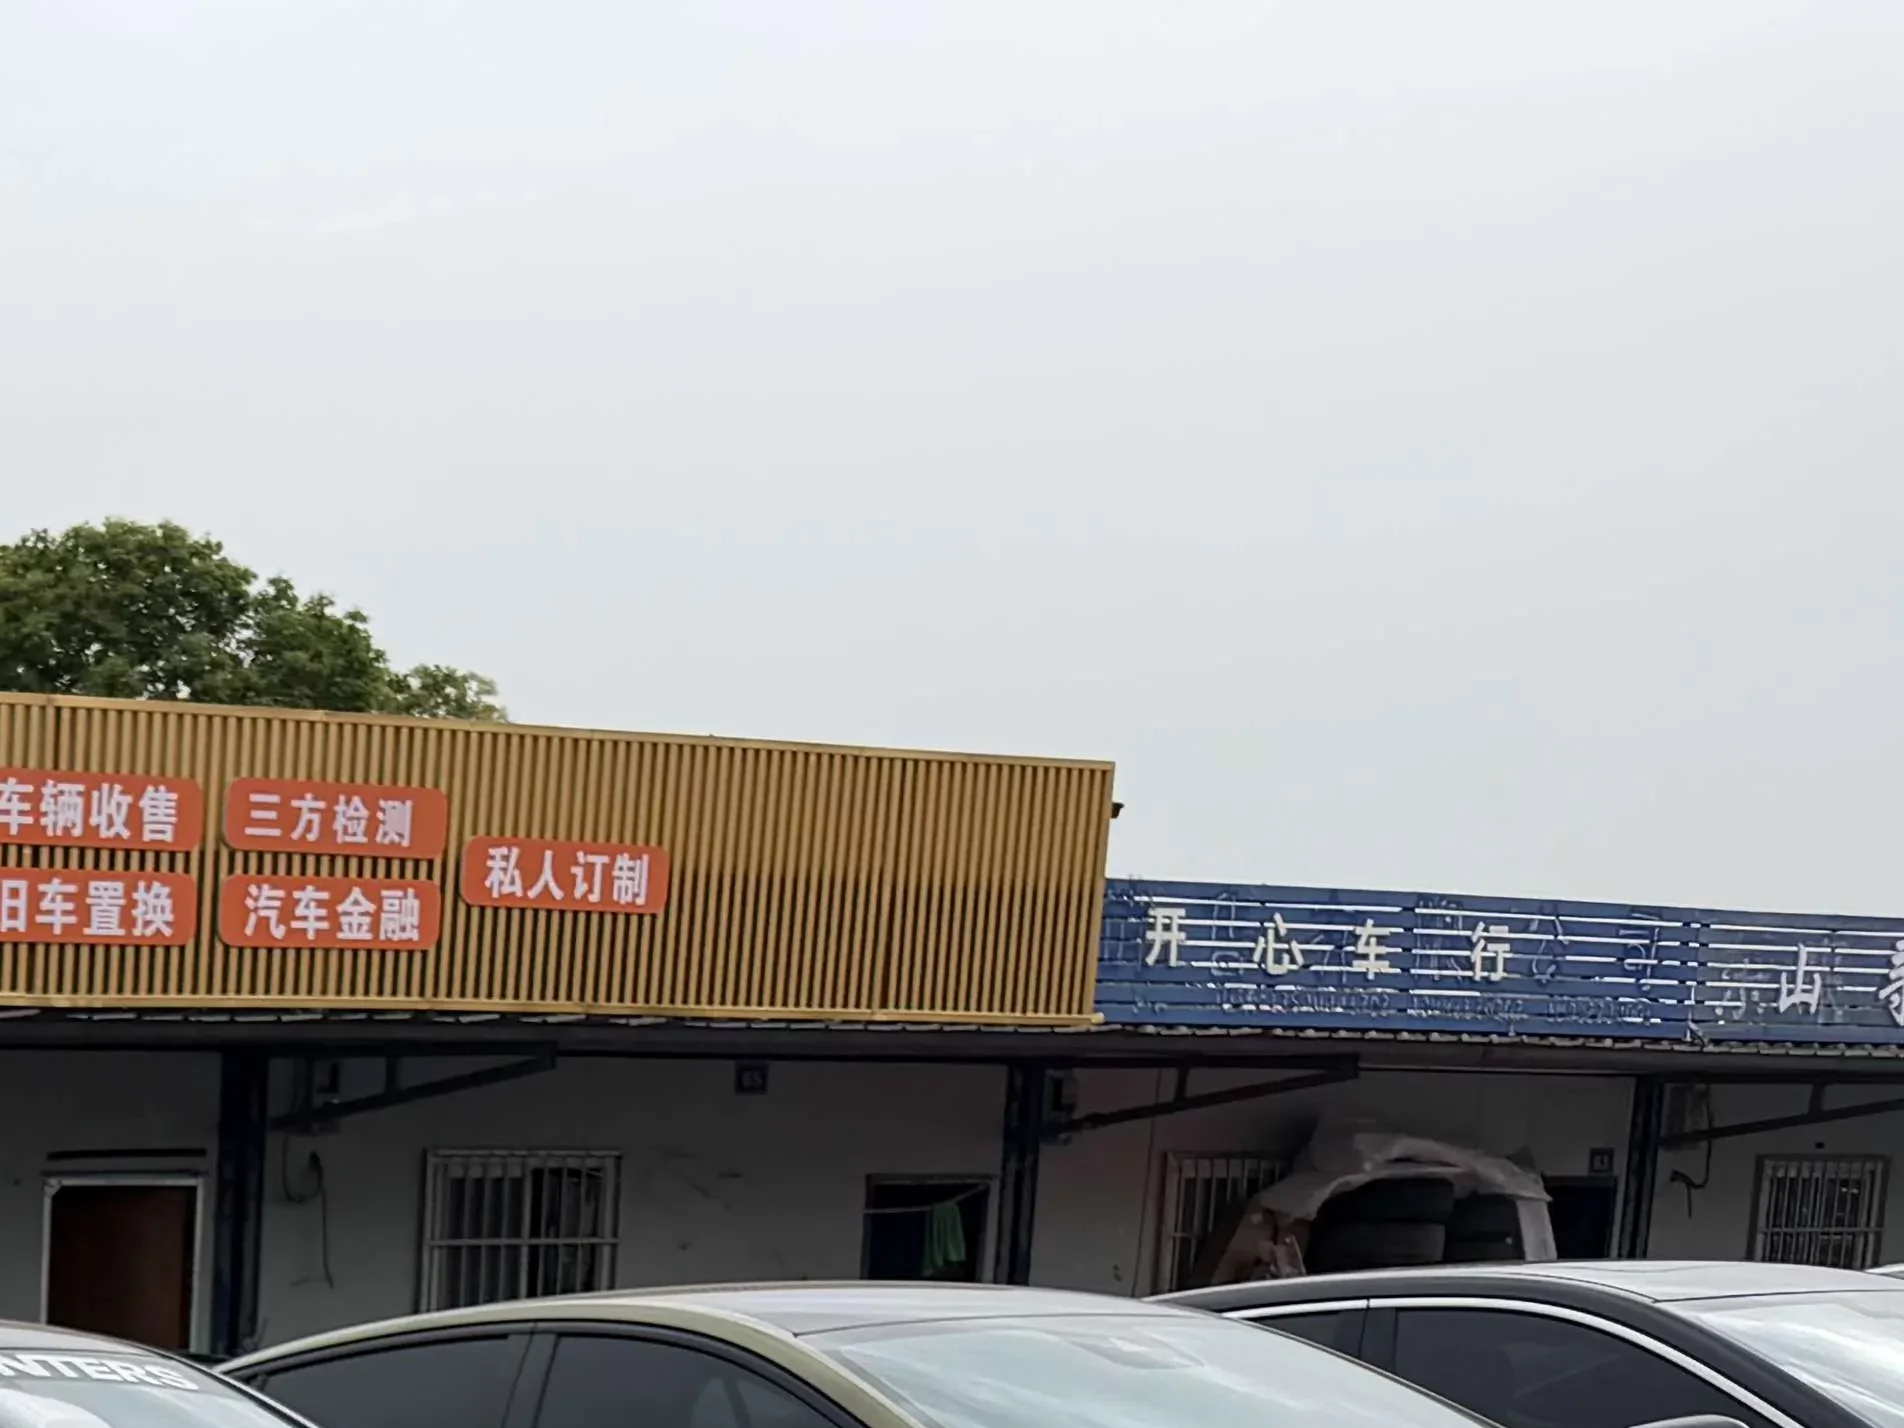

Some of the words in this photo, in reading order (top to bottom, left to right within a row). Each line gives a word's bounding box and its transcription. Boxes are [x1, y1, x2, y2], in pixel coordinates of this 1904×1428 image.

[244, 791, 414, 848] 三方检测
[485, 845, 650, 907] 私人订制
[245, 883, 421, 943] 汽车金融
[1145, 906, 1510, 982] 开心车行
